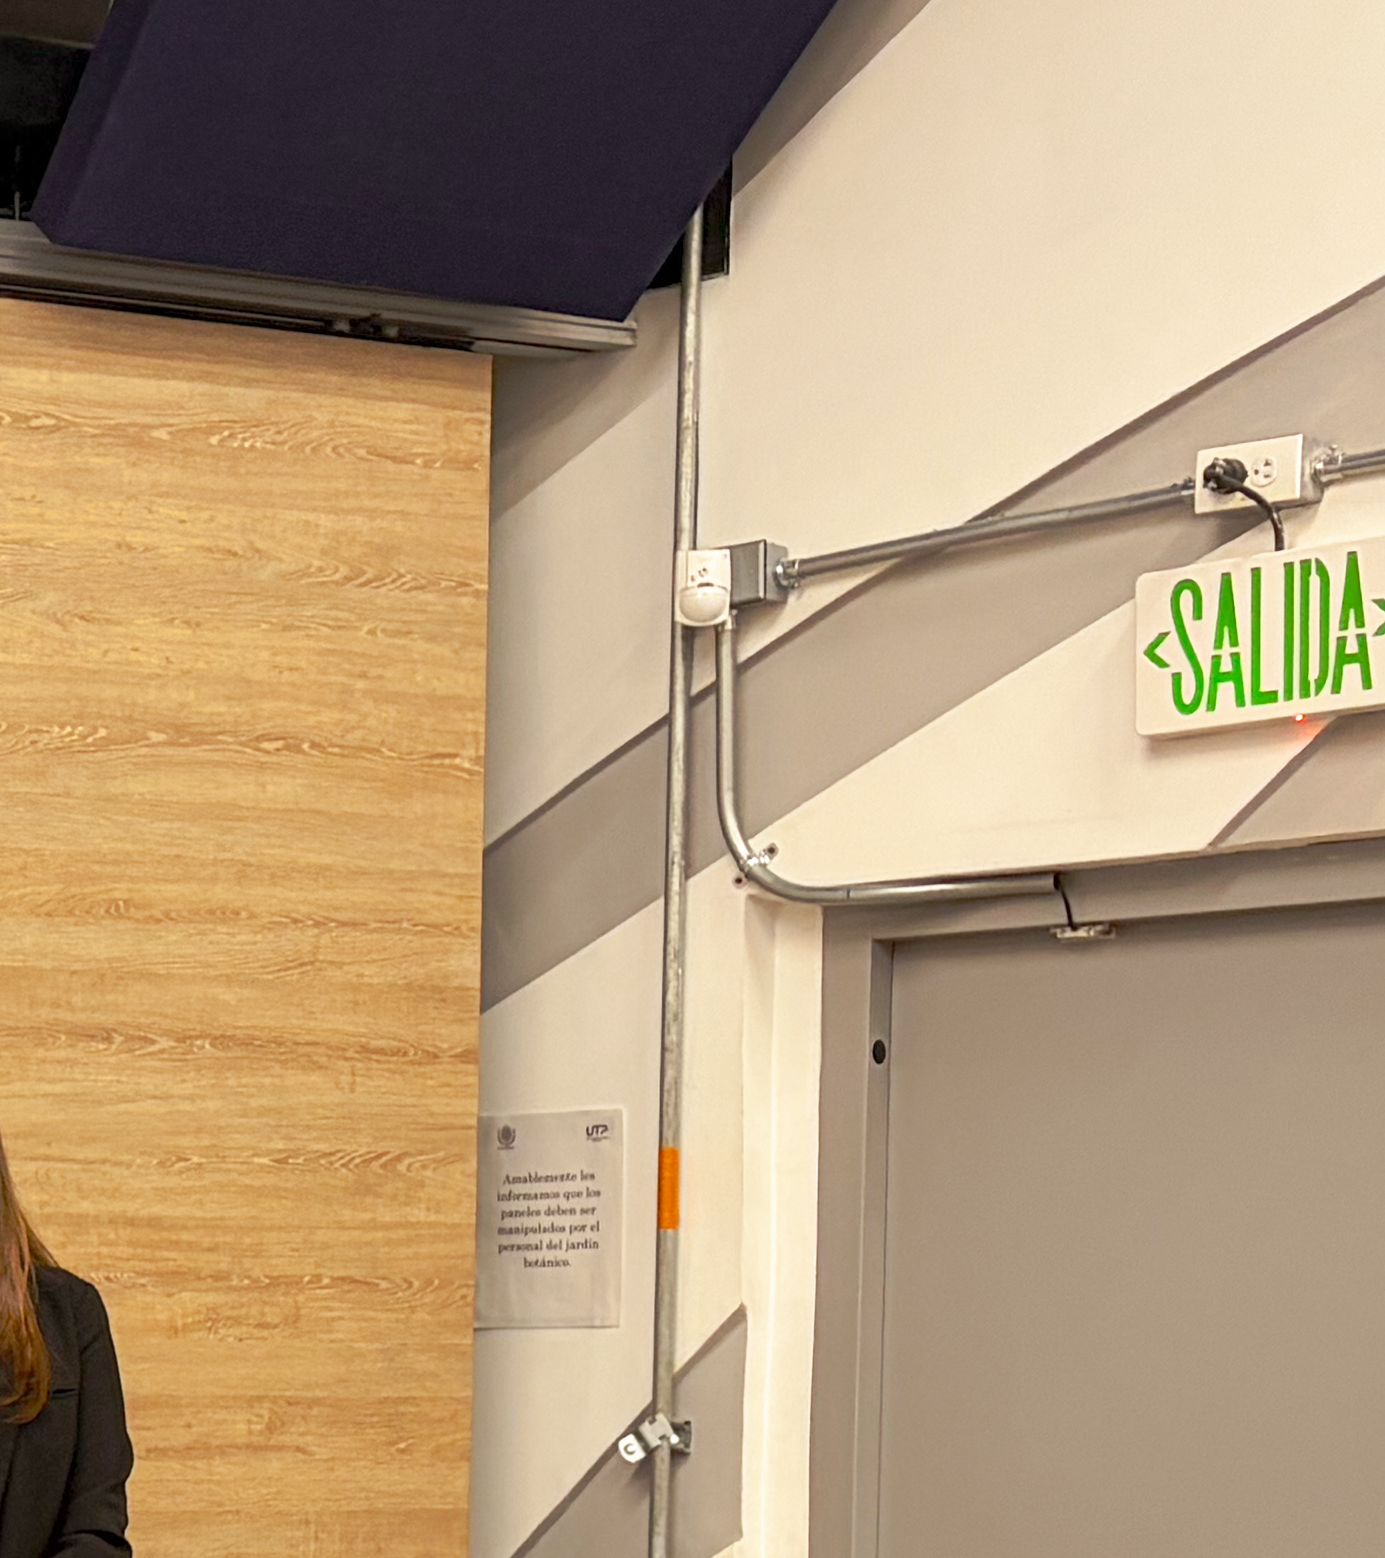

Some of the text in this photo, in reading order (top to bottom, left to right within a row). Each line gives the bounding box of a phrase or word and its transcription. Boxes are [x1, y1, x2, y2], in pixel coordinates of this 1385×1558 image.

[1170, 551, 1373, 716] SALIDA
[497, 1187, 601, 1202] informamos que los
[501, 1204, 597, 1221] paneles deben ser
[497, 1220, 600, 1237] manipulados por el
[498, 1240, 543, 1254] personal
[546, 1239, 562, 1251] del
